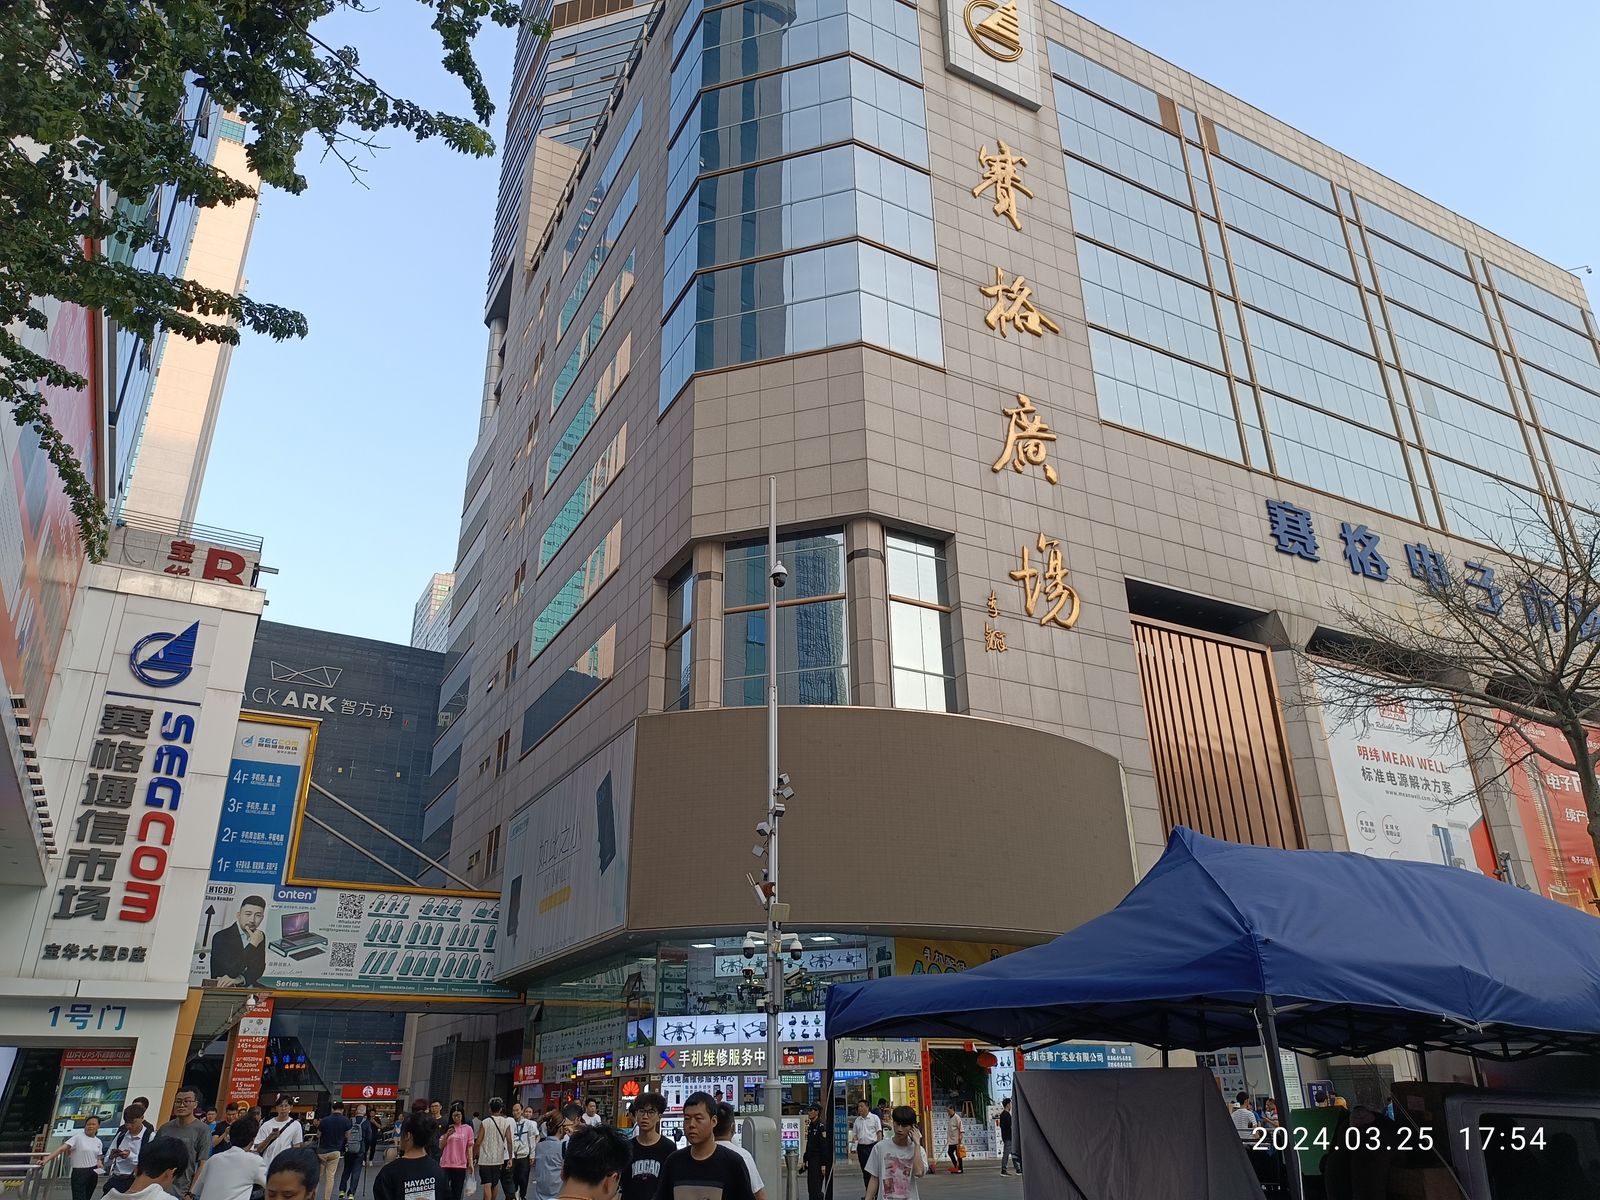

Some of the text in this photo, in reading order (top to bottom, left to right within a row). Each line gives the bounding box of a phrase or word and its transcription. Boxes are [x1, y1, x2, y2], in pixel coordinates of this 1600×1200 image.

[340, 698, 395, 720] 智方舟
[1356, 745, 1448, 774] 明纬 MEAN WELL
[233, 769, 249, 784] 4F
[1361, 766, 1453, 796] 标准电源解决方案
[53, 703, 154, 922] 赛格通信市场
[227, 798, 243, 813] 3F
[222, 827, 238, 842] 2F
[217, 857, 231, 872] 1F
[208, 885, 233, 895] H1C98
[277, 889, 312, 901] onten
[42, 942, 148, 963] 宝华大厦B座
[48, 1003, 127, 1030] 1号门
[618, 1054, 646, 1071] 手机维修站
[678, 1047, 766, 1068] 手机维修服务中
[404, 1177, 436, 1188] HAYACO
